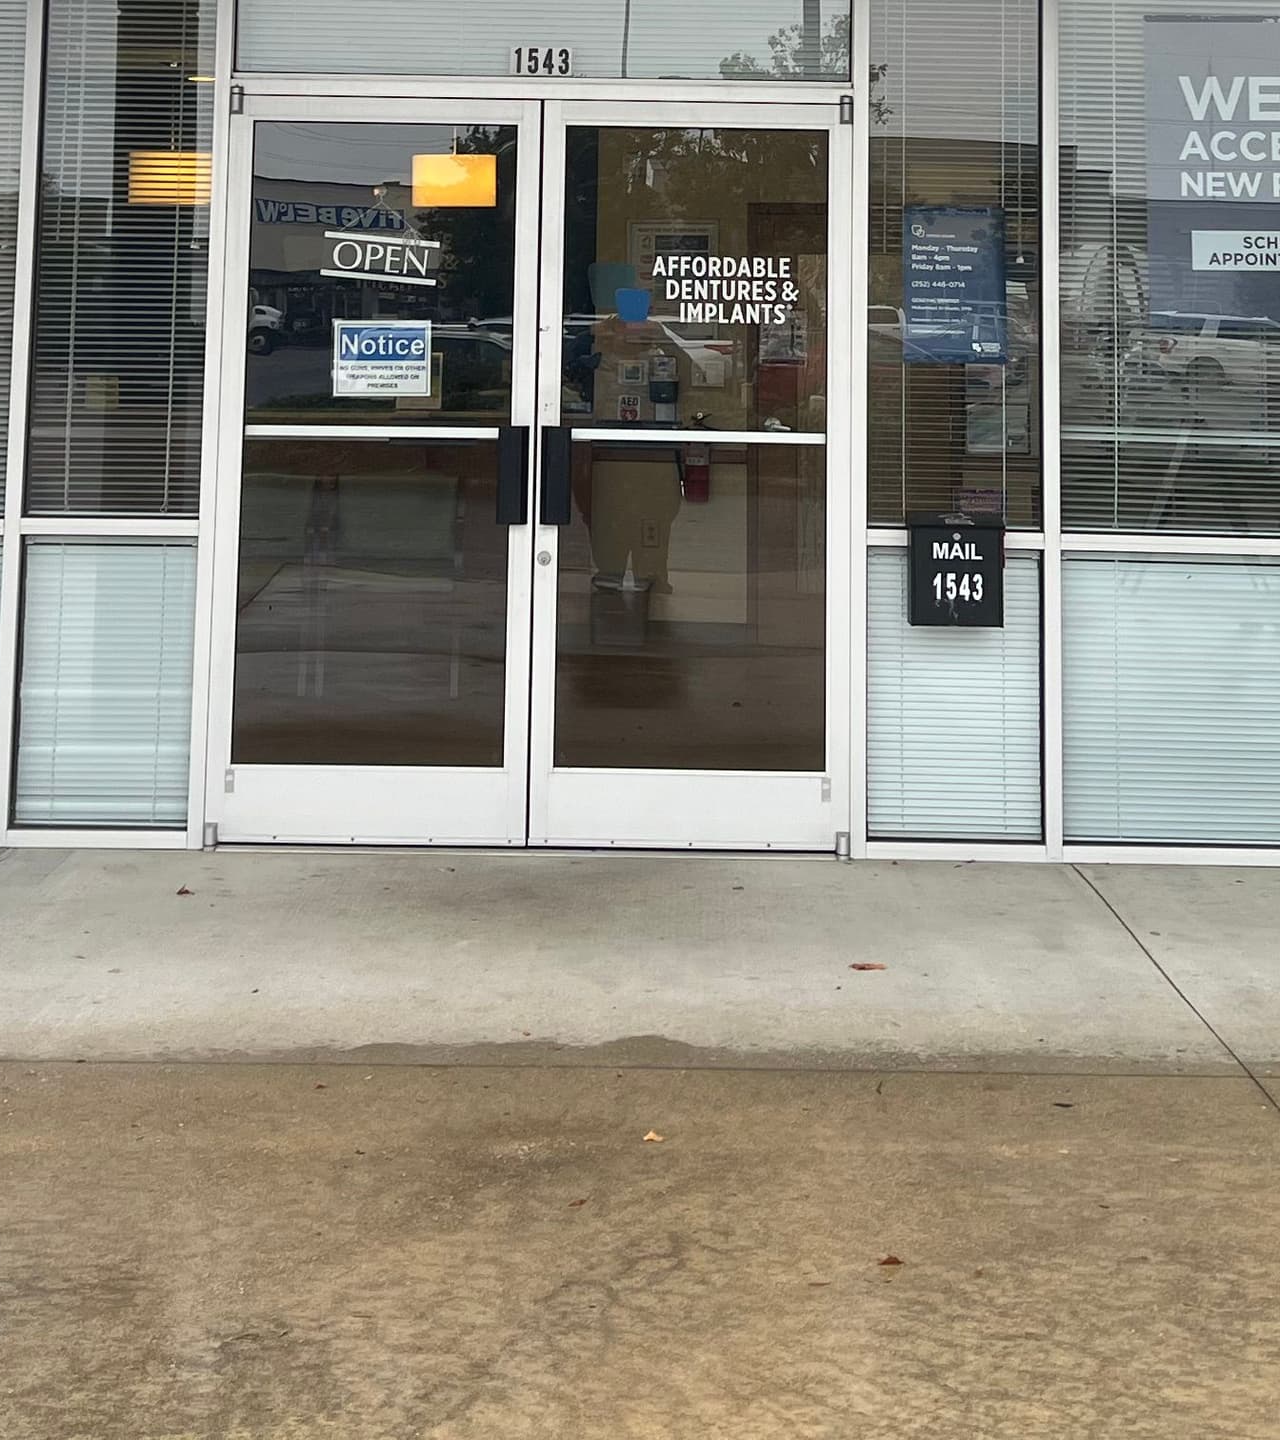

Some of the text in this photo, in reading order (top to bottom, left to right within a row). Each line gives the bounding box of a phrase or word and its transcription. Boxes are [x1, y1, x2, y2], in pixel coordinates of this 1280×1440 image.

[514, 47, 570, 75] 1543
[1180, 171, 1263, 198] NEW
[332, 240, 429, 277] OPEN
[652, 255, 791, 279] AFFORDABLE
[666, 279, 800, 302] DENTURES &
[341, 333, 425, 356] Notice
[932, 542, 984, 561] MAIL
[932, 572, 984, 602] 1543
